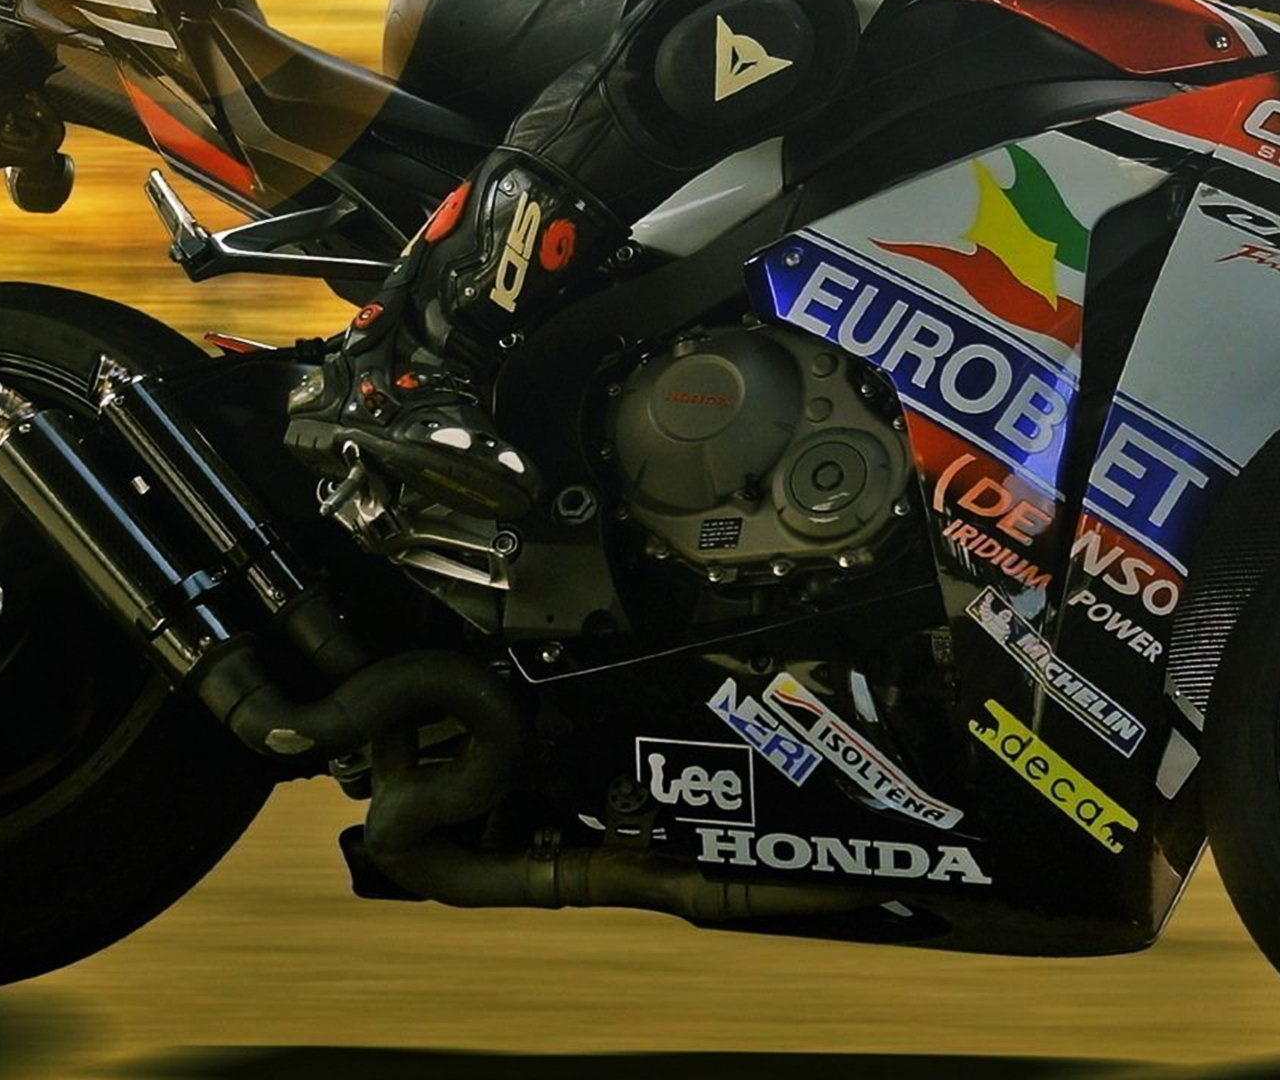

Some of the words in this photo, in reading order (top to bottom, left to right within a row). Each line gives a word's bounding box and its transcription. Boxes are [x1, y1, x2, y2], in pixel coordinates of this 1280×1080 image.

[942, 519, 1053, 589] IRIDIUM
[1067, 589, 1163, 664] POWER
[1017, 631, 1140, 741] MICHELIN
[648, 753, 743, 811] Lee
[816, 726, 946, 821] ISOLTENA
[1001, 732, 1104, 826] deca
[695, 828, 993, 885] HONDA
